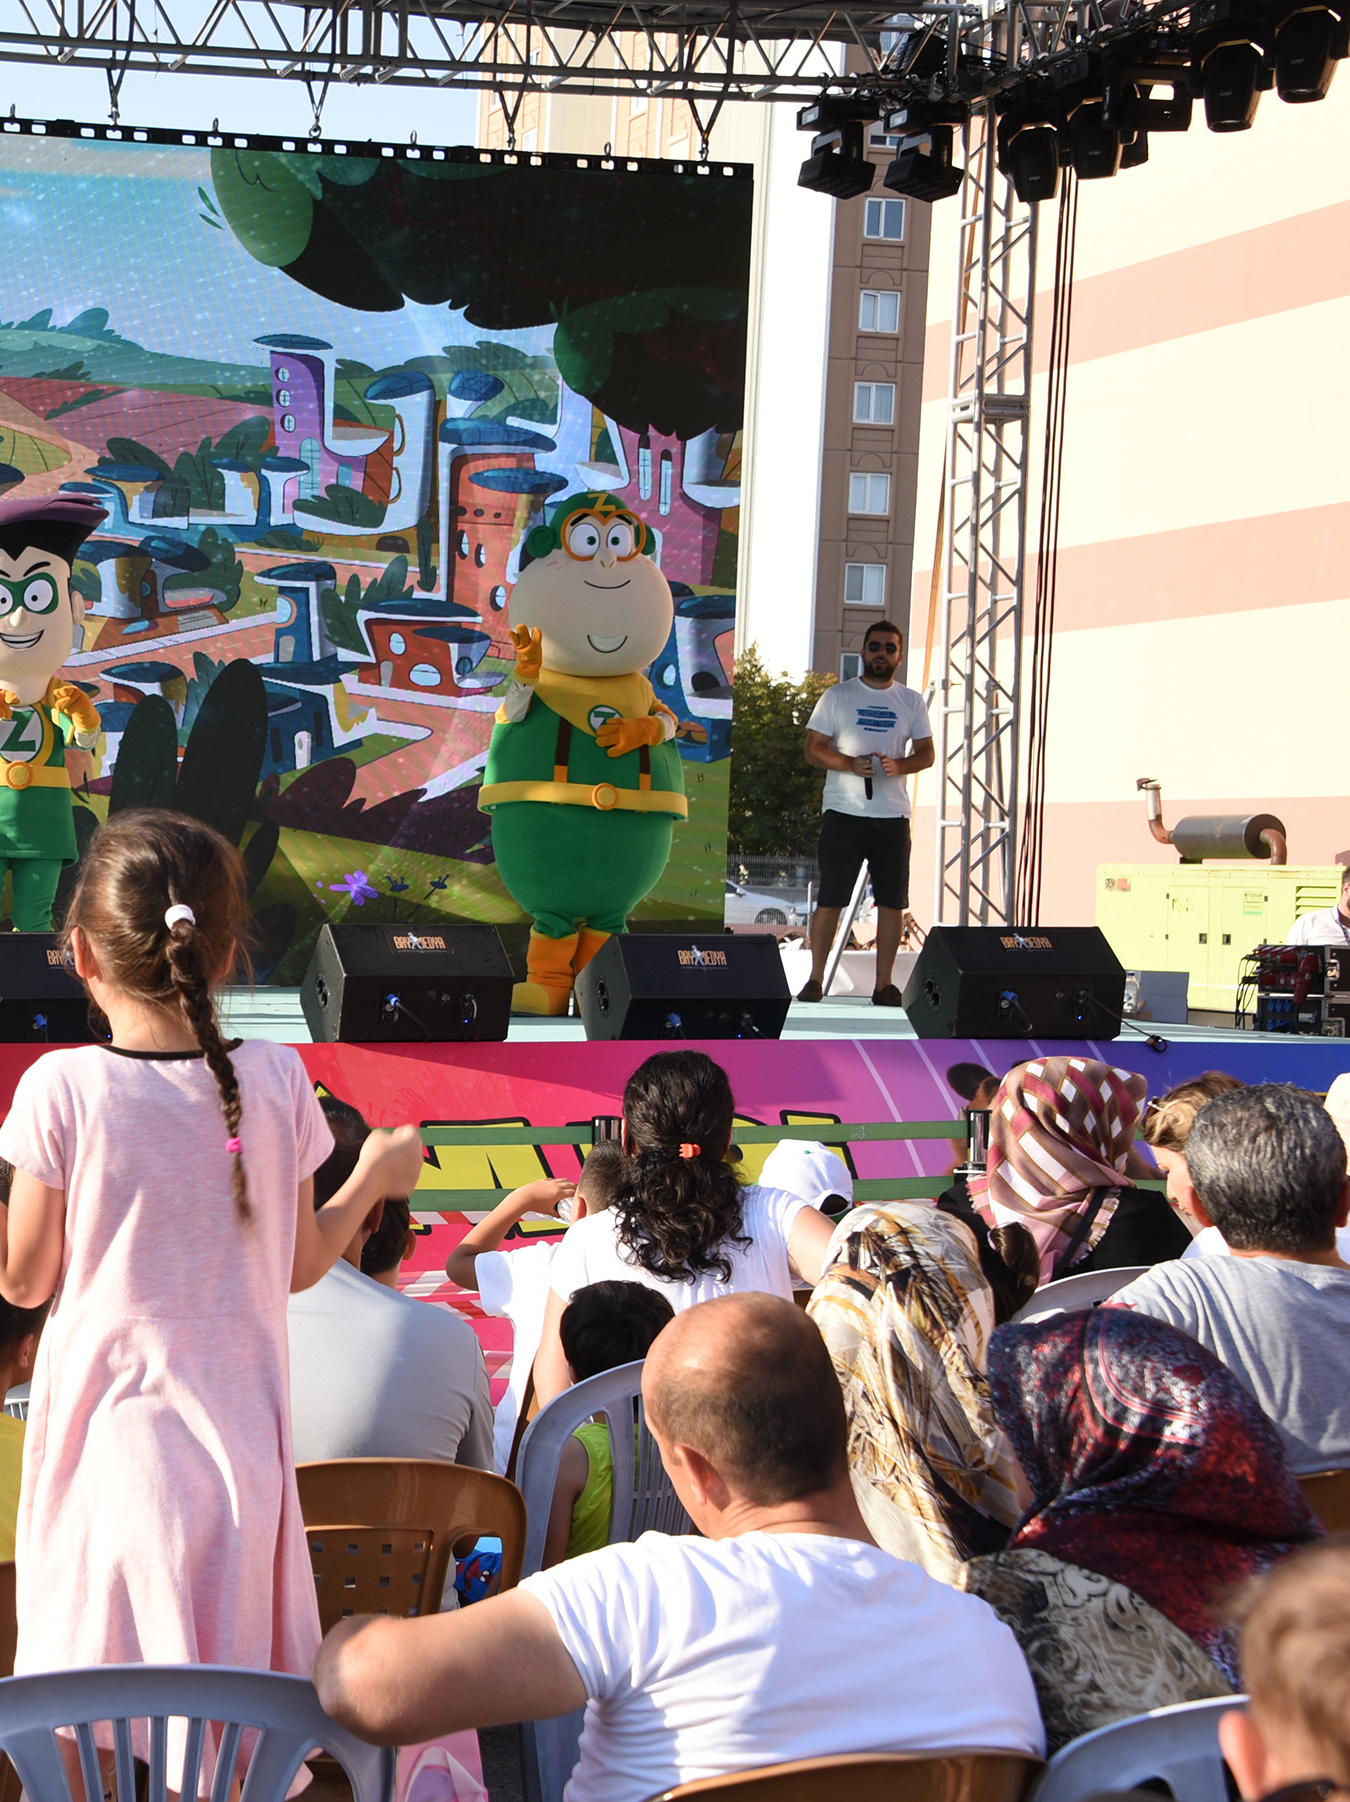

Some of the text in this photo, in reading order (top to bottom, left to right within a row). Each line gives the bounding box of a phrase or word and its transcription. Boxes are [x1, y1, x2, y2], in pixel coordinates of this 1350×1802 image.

[587, 493, 616, 512] Z
[0, 709, 37, 752] Z
[393, 936, 411, 949] BAY
[677, 950, 695, 966] BAY
